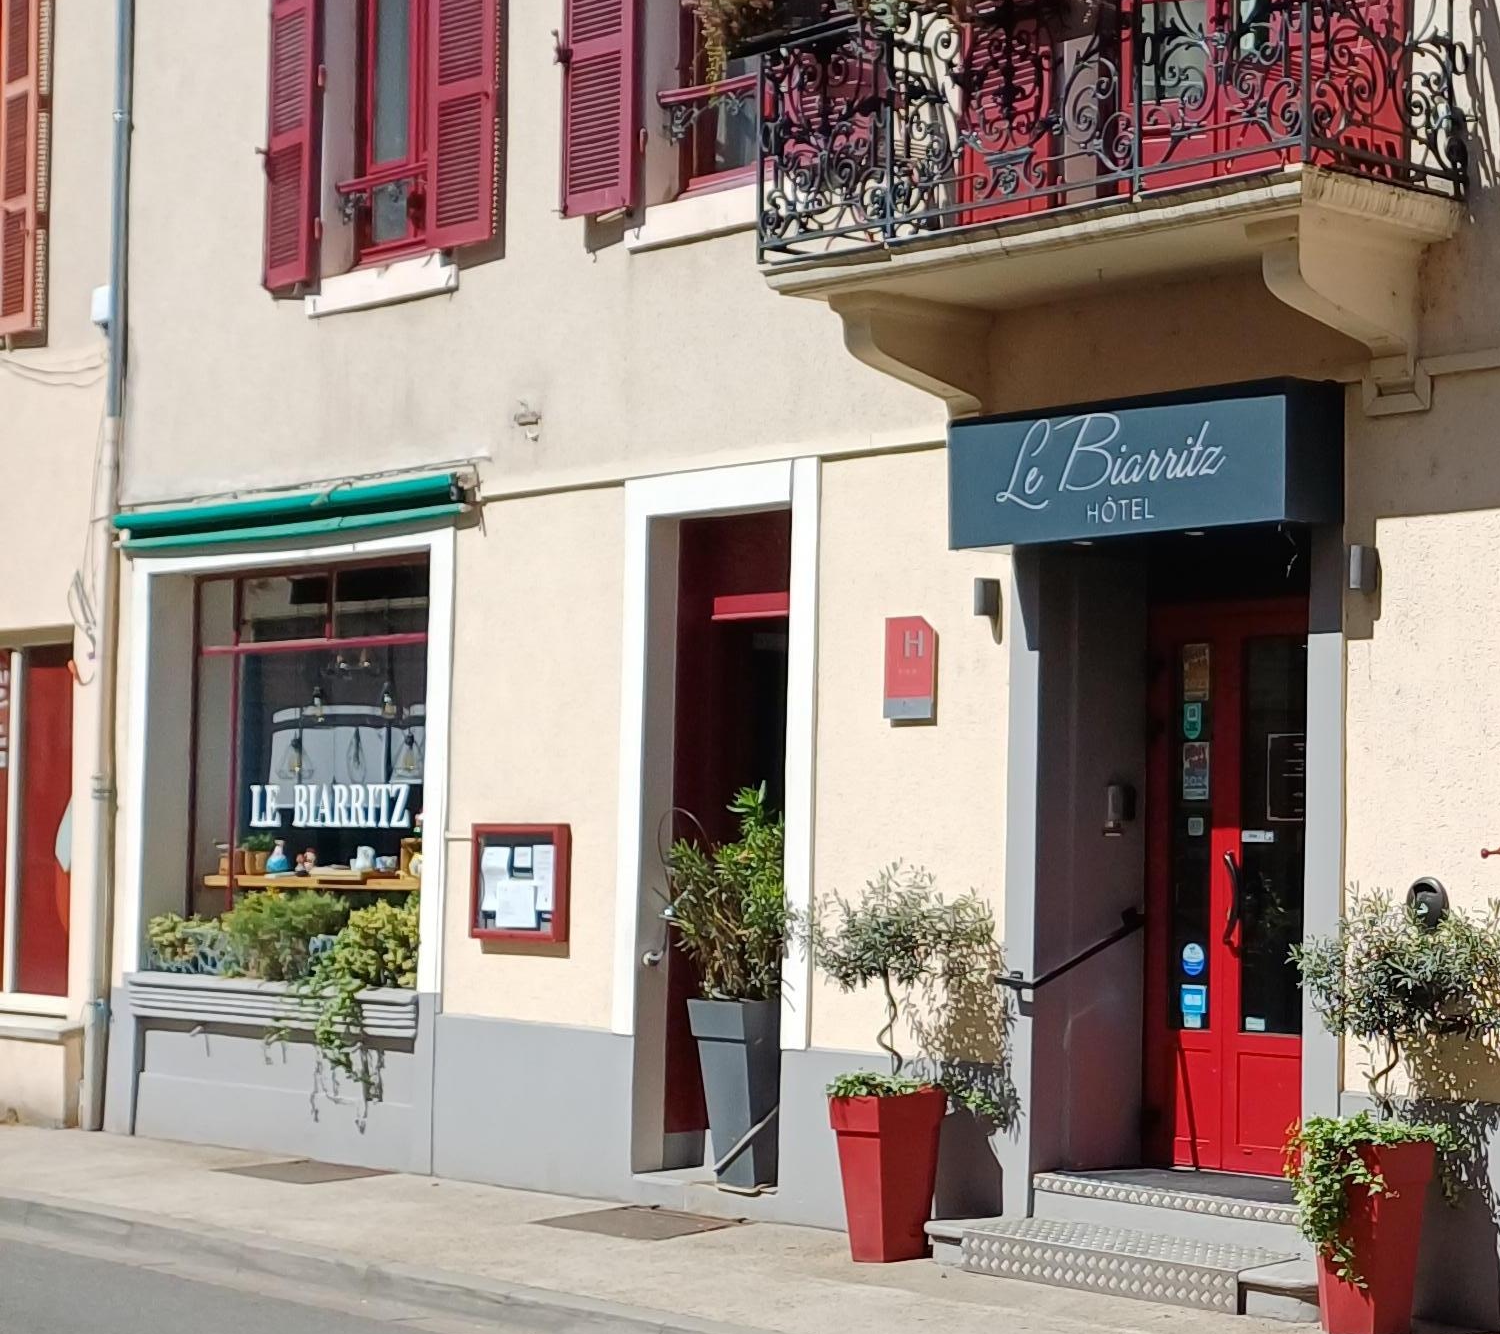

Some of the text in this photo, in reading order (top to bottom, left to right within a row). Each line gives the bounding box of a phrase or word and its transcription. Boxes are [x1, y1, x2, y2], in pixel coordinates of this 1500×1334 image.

[995, 412, 1227, 510] Le Biarritz
[1086, 495, 1156, 524] HÔTEL
[904, 629, 925, 658] H
[249, 783, 412, 829] LE BIARRITZ
